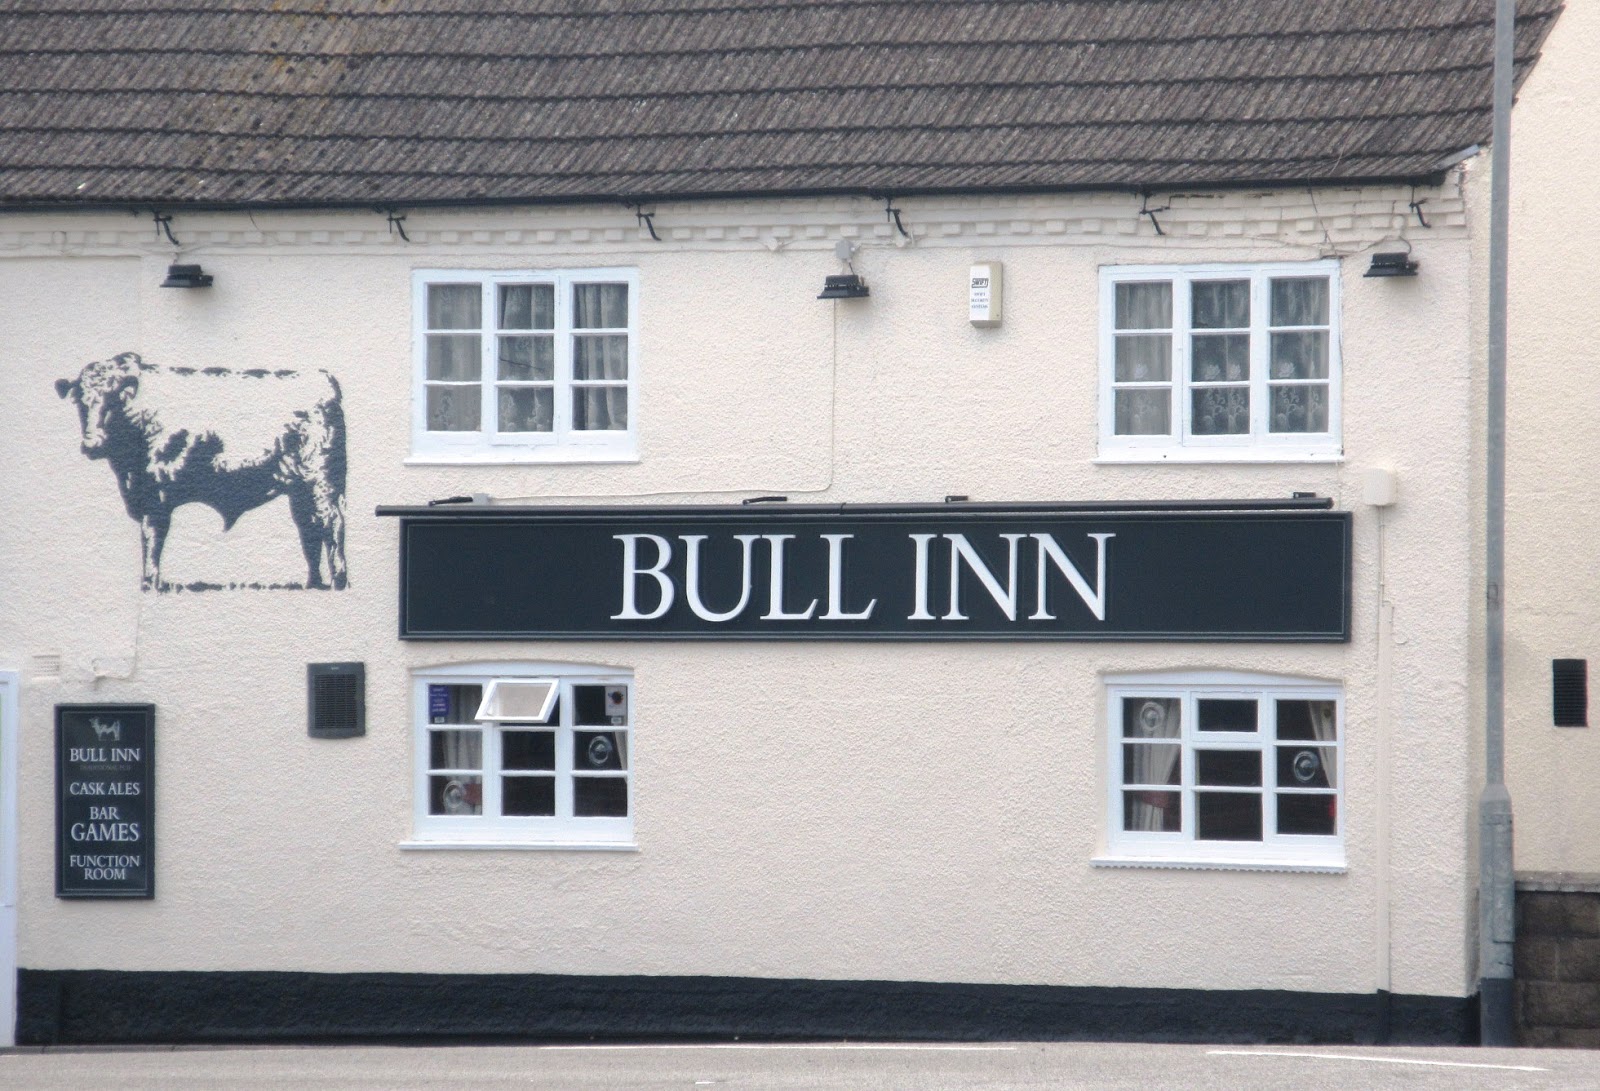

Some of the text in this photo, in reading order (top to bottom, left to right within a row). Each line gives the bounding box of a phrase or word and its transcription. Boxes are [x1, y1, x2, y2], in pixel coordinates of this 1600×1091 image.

[610, 533, 1116, 622] BULL INN
[69, 748, 140, 762] BULL INN
[69, 782, 140, 796] CASK ALES
[89, 806, 120, 820] BAR
[71, 823, 140, 842] GAMES
[70, 855, 140, 868] FUNCTION
[84, 868, 126, 880] ROOM
